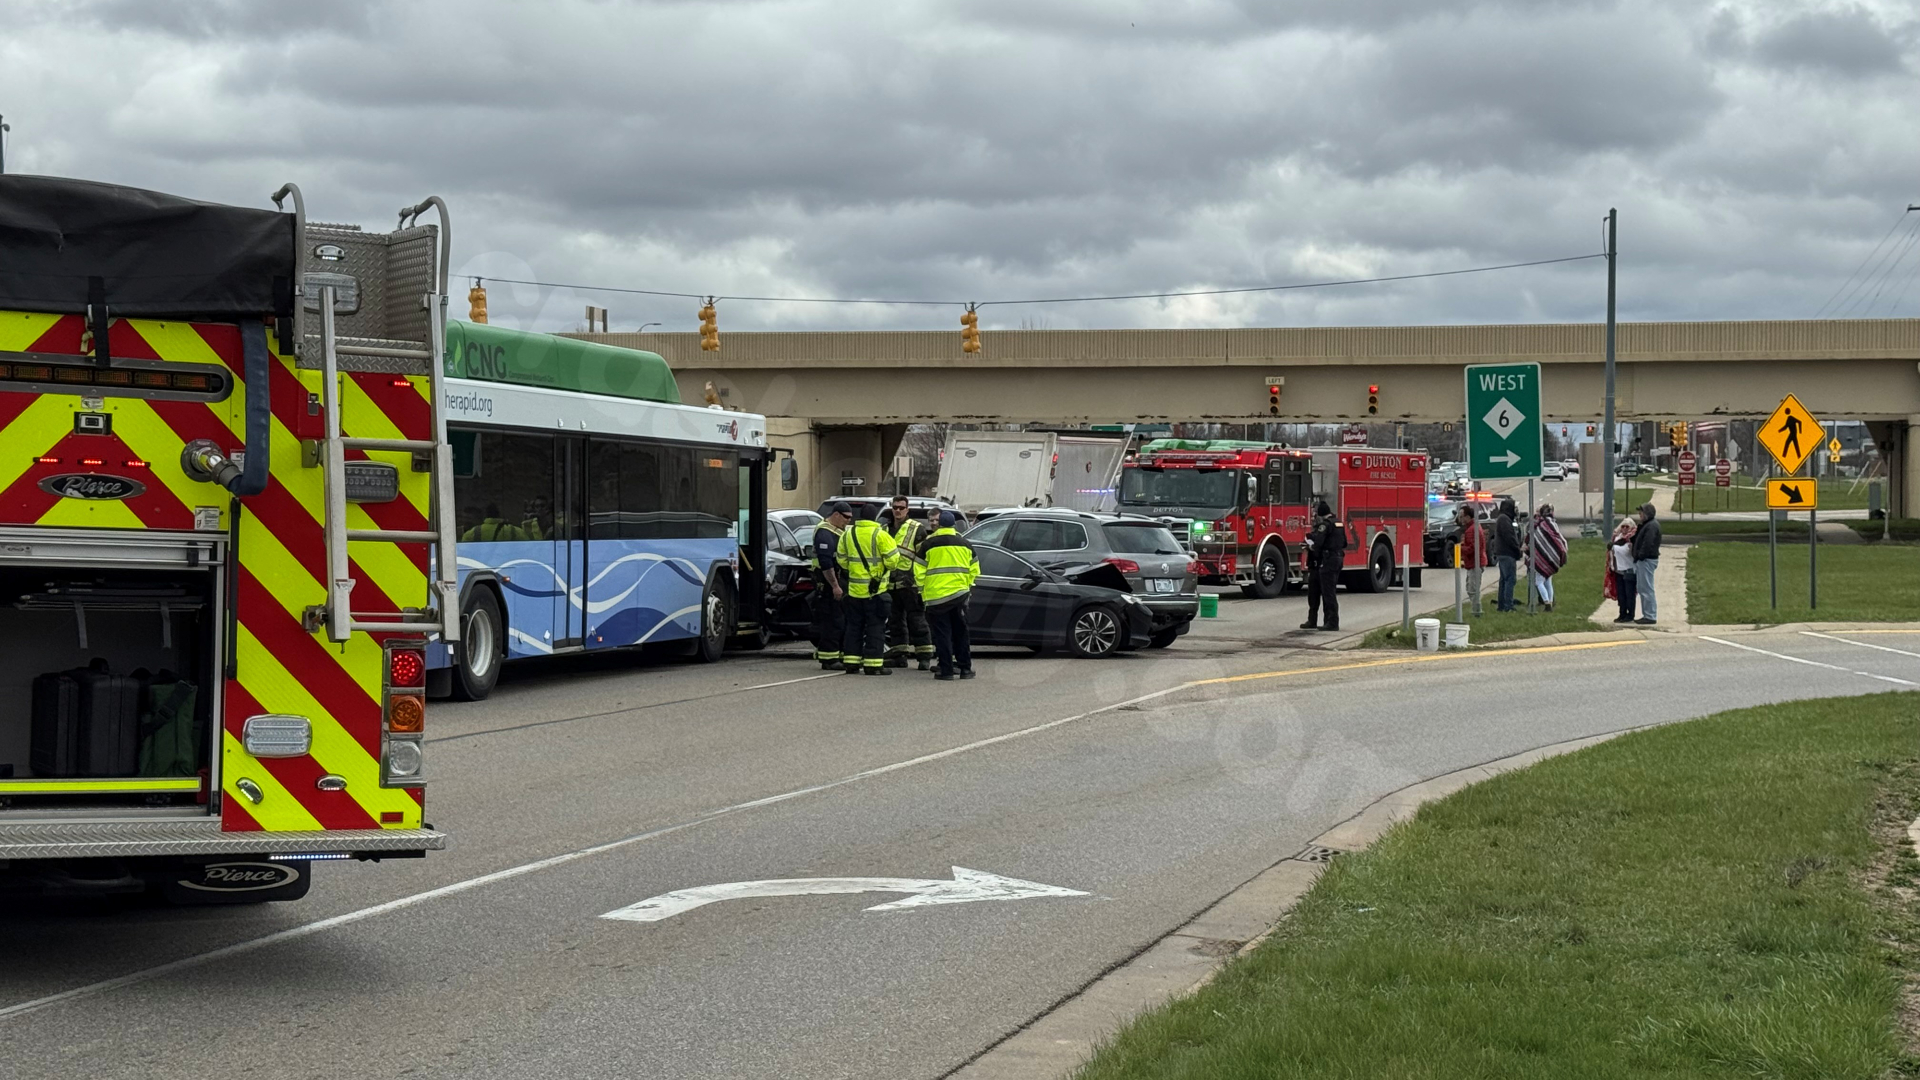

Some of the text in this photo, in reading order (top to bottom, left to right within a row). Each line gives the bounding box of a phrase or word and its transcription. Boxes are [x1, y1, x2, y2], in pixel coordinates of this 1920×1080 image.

[467, 342, 507, 379] CNG
[1479, 374, 1526, 391] WEST
[1498, 410, 1510, 428] 6
[1366, 455, 1402, 470] DUTTON
[62, 476, 122, 494] Pierce
[203, 867, 276, 884] Pierce
